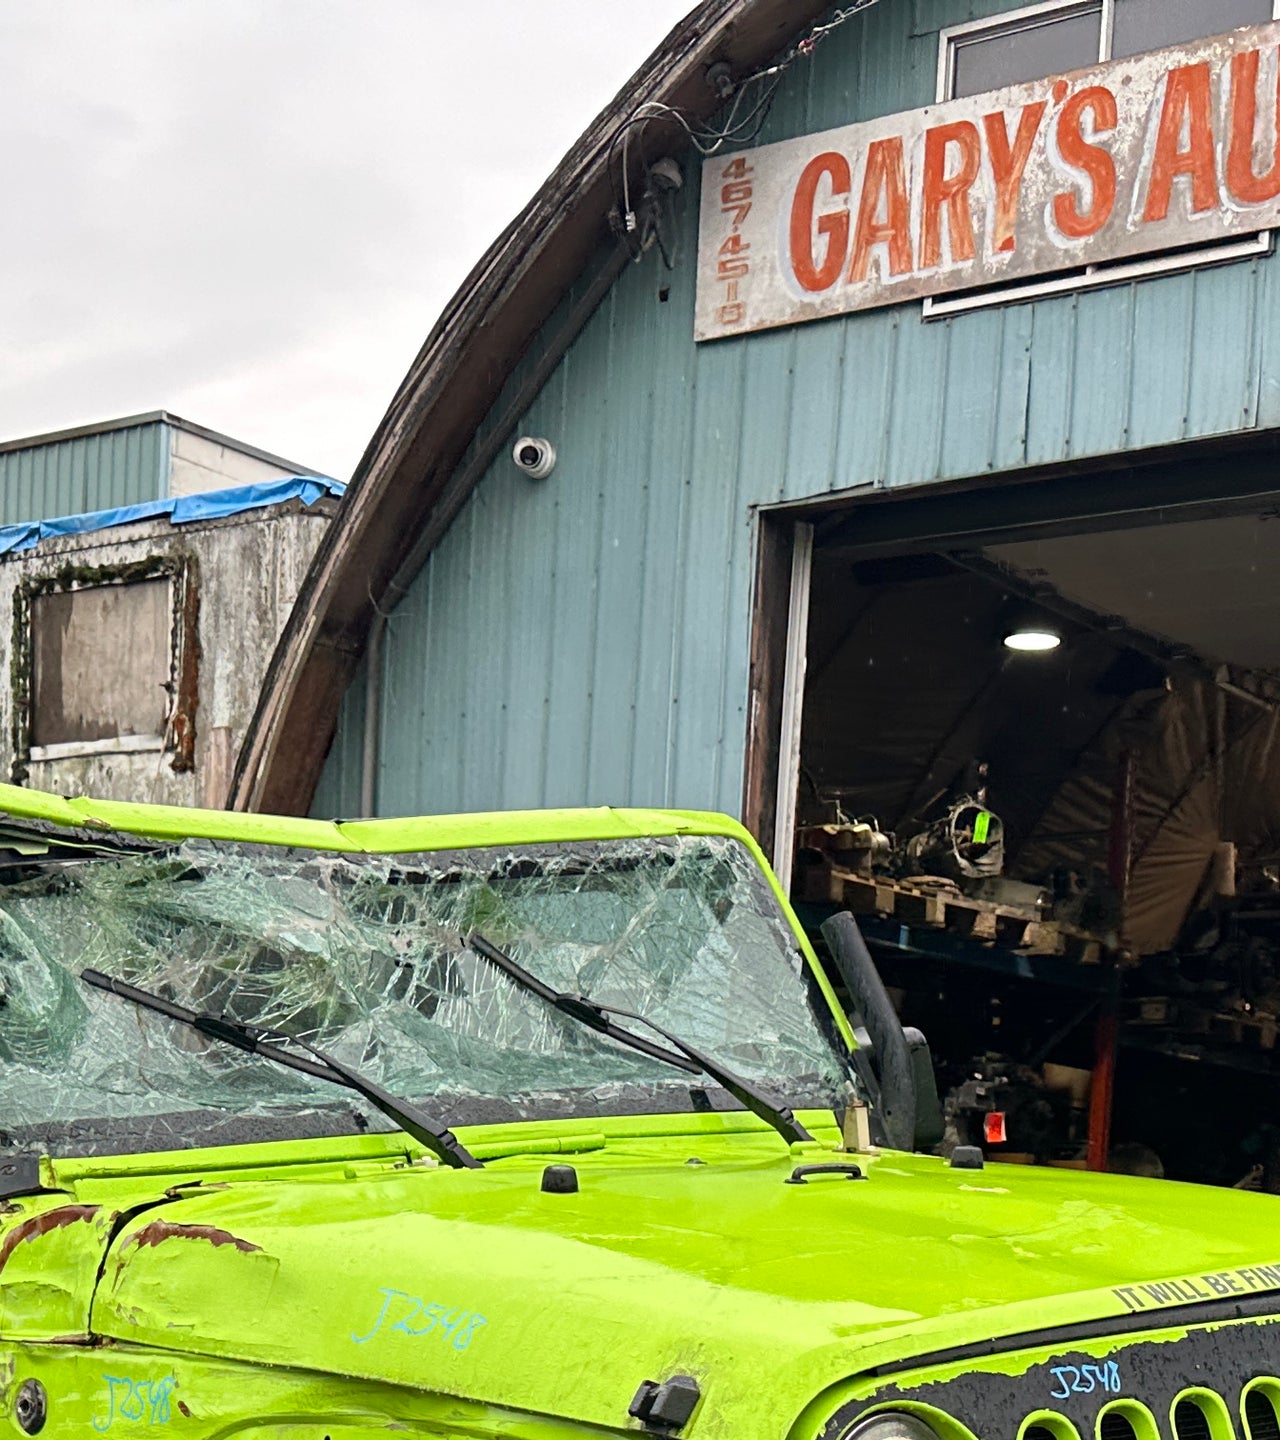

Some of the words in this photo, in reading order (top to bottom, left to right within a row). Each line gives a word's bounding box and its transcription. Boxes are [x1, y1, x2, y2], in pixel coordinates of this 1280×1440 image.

[788, 80, 1118, 293] GARY'S
[351, 1287, 489, 1351] J2548
[1111, 1286, 1145, 1309] IT
[1138, 1279, 1210, 1305] WILL
[1201, 1272, 1245, 1295] BE
[91, 1373, 175, 1432] J2548
[1049, 1360, 1121, 1399] J2548
